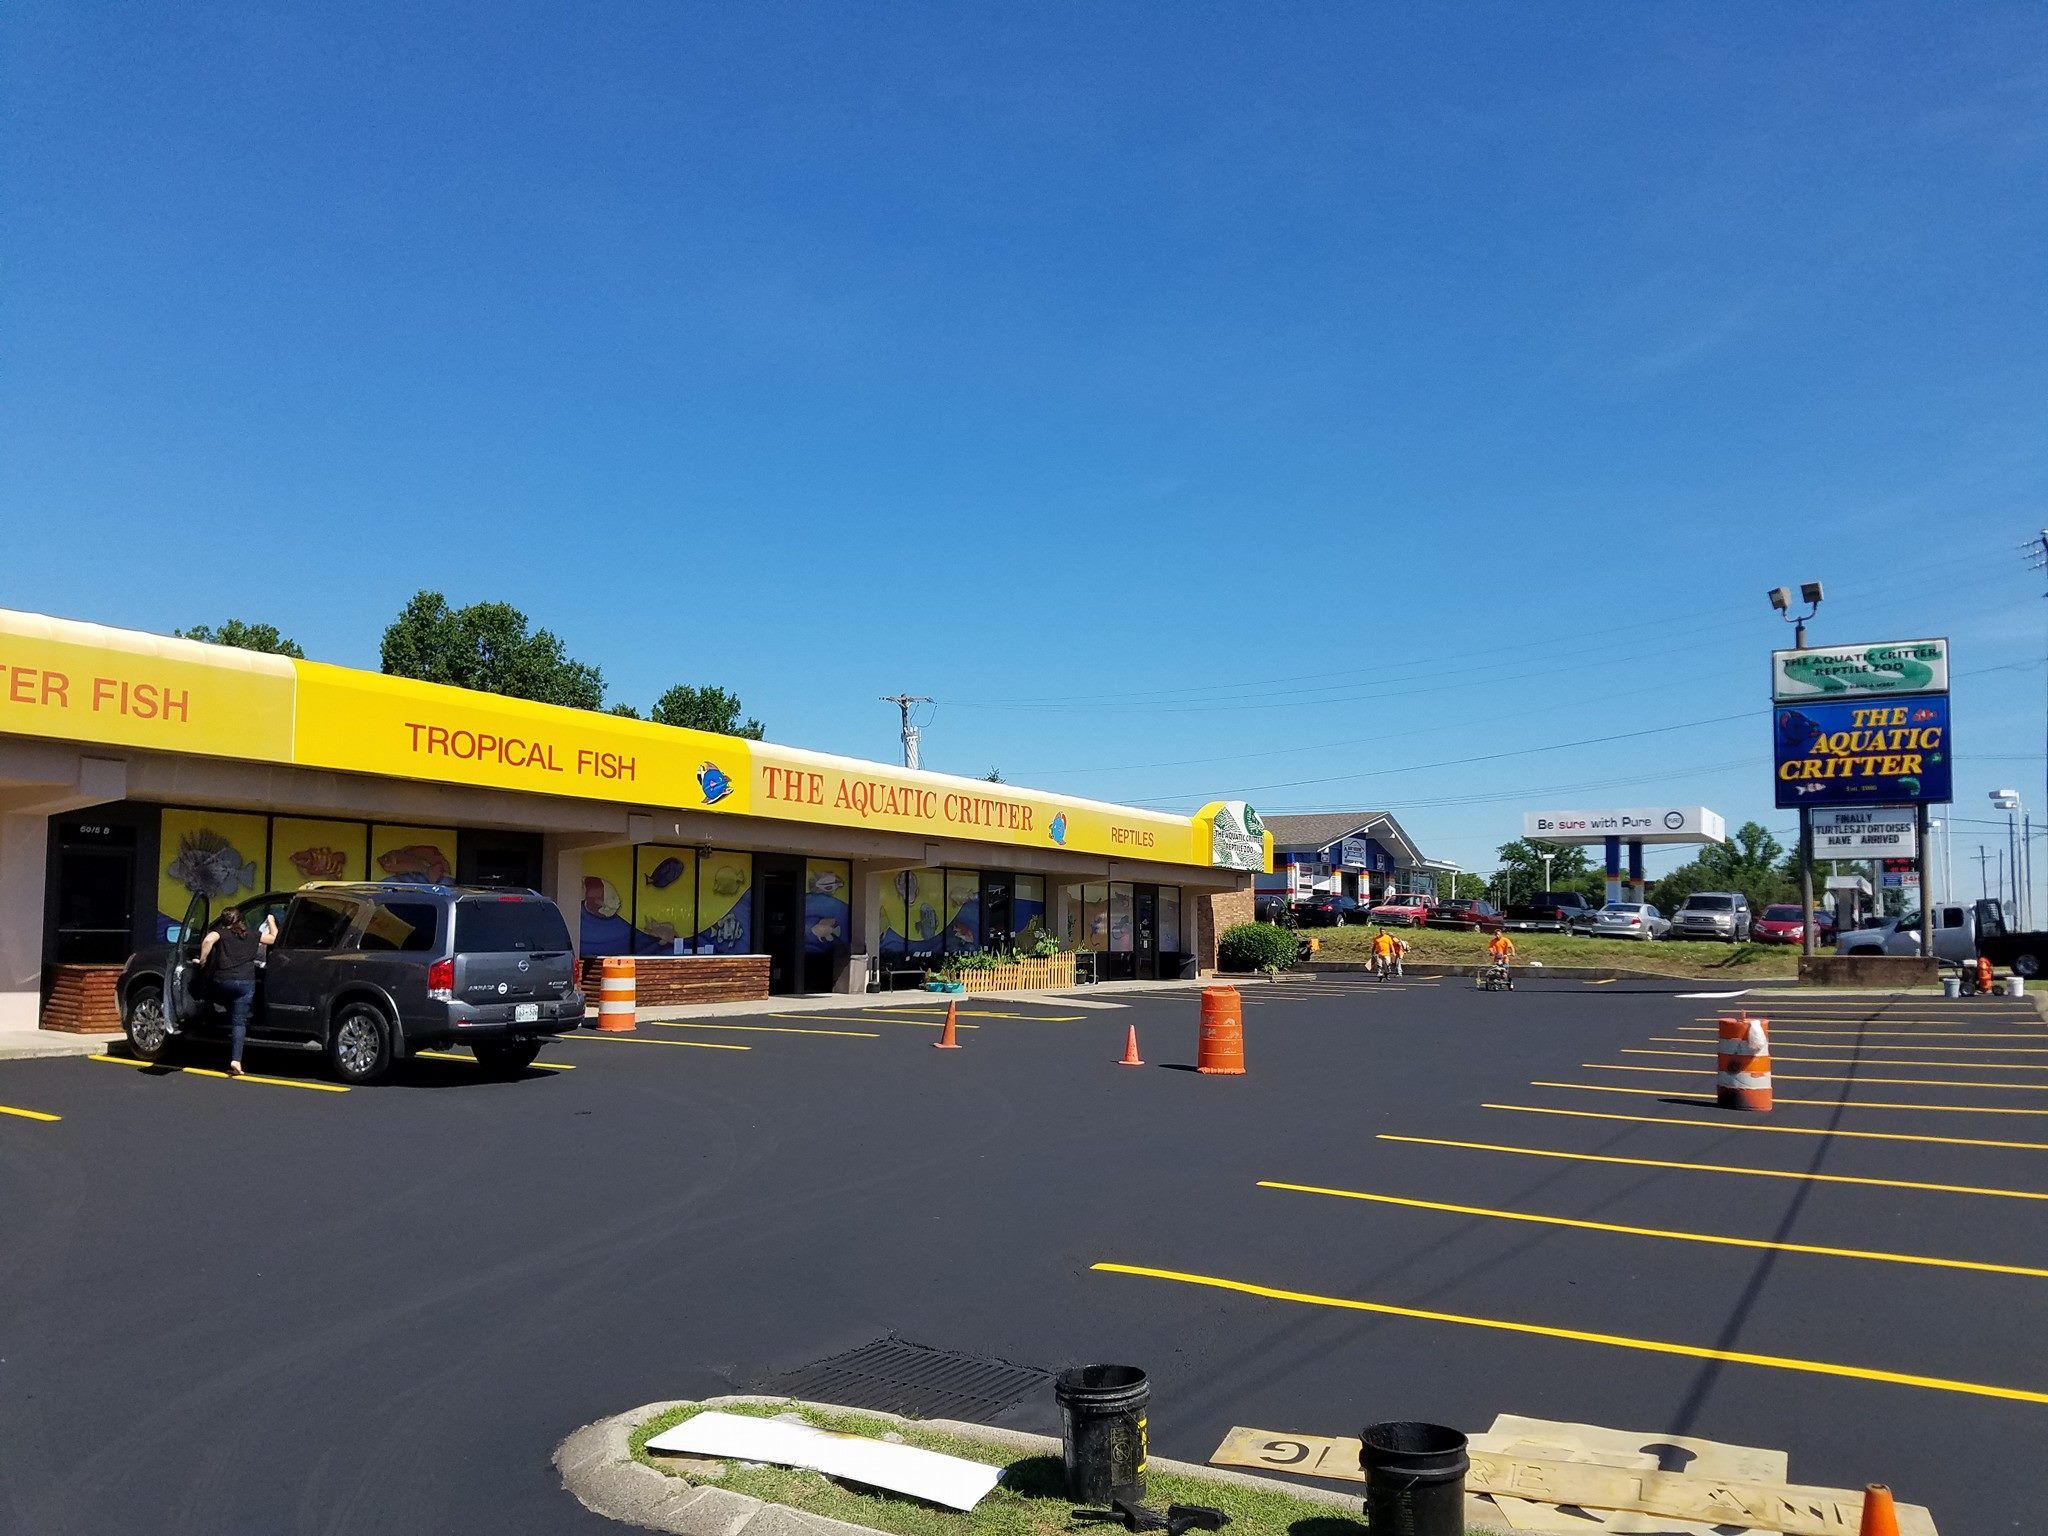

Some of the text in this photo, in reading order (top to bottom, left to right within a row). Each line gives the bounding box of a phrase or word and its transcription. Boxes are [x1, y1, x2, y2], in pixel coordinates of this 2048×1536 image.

[1783, 649, 1937, 667] THE AQUATIC CRITTER
[1814, 662, 1904, 676] REPTILE ZOO
[0, 664, 189, 722] ER FISH
[1852, 707, 1909, 727] THE
[405, 722, 635, 781] TROPICAL FISH
[1809, 727, 1942, 757] AQUATIC
[1778, 754, 1923, 781] CRITTER
[763, 766, 1034, 831] THE AQUATIC CRITTER
[1538, 816, 1652, 830] Be sure with Pure
[1835, 813, 1872, 823] FINALLY
[1111, 827, 1155, 847] REPTILES
[1214, 830, 1225, 839] THE
[1225, 831, 1246, 842] AQUATIC
[1828, 834, 1900, 845] HAVE ARRIVED
[1226, 843, 1254, 854] REPTILE ZOO
